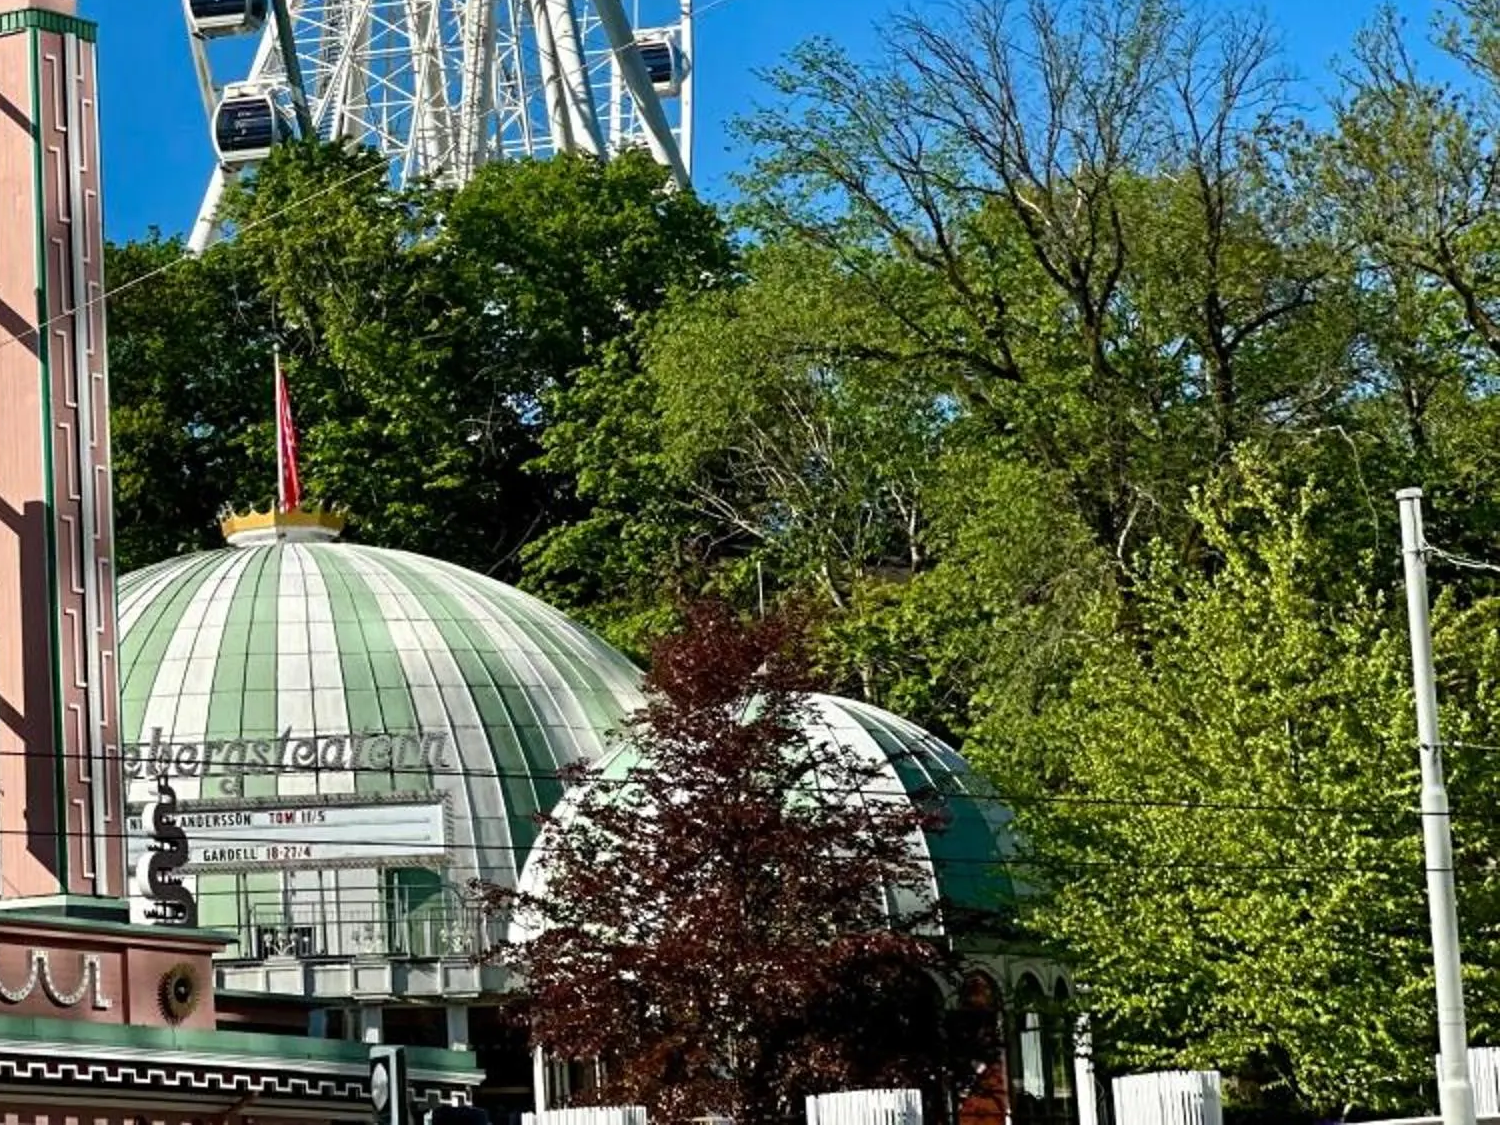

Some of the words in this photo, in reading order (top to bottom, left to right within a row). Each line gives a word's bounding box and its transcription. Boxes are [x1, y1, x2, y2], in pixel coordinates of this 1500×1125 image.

[180, 812, 251, 828] ANDERSSON
[269, 811, 295, 825] TOM
[203, 845, 257, 862] GARDELL
